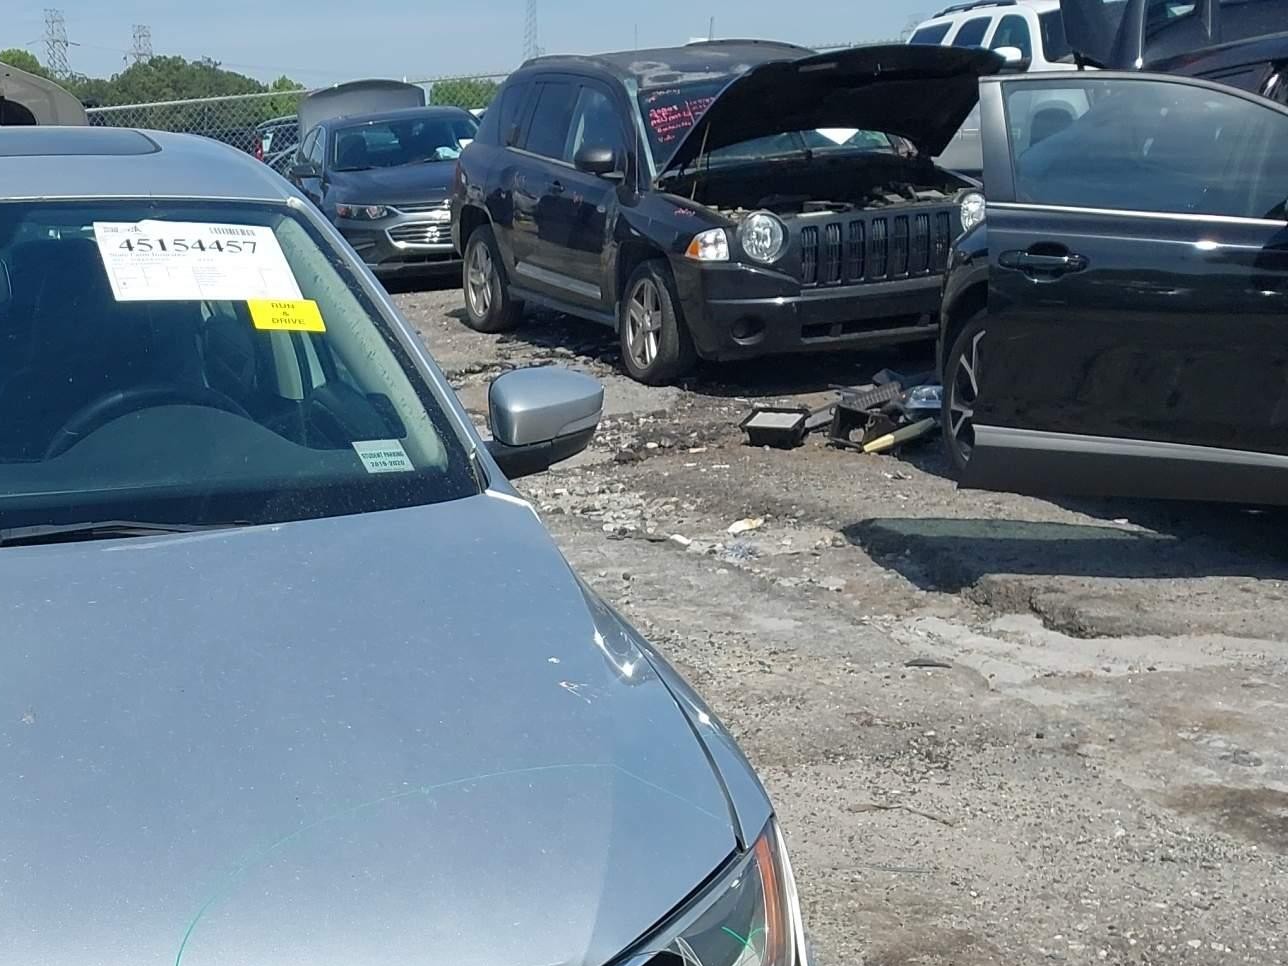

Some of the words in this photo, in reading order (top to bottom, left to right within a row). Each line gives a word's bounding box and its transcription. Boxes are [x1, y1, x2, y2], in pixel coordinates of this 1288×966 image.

[118, 238, 257, 254] 45154457
[271, 317, 305, 325] DRIVE
[361, 451, 383, 459] STUDENT
